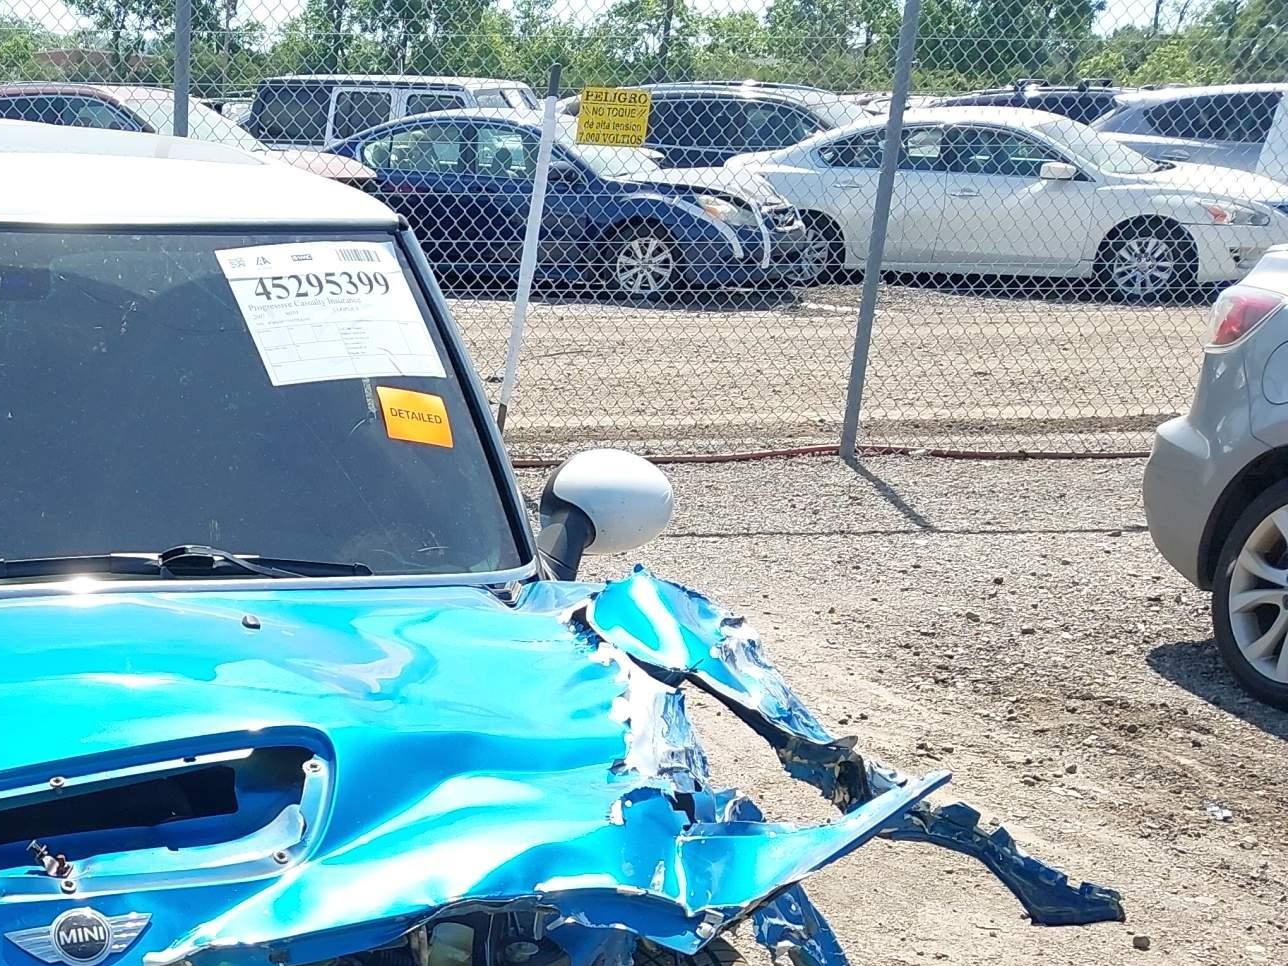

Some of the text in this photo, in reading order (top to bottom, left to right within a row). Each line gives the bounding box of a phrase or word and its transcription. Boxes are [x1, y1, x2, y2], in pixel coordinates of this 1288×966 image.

[585, 90, 648, 104] PELIGRO
[592, 106, 637, 118] NO TOQUE
[584, 120, 594, 129] de
[596, 120, 610, 130] alta
[602, 133, 643, 145] VOLTIOS
[254, 271, 389, 300] 45295399
[390, 407, 442, 424] DETAILED
[59, 926, 105, 945] MINI
